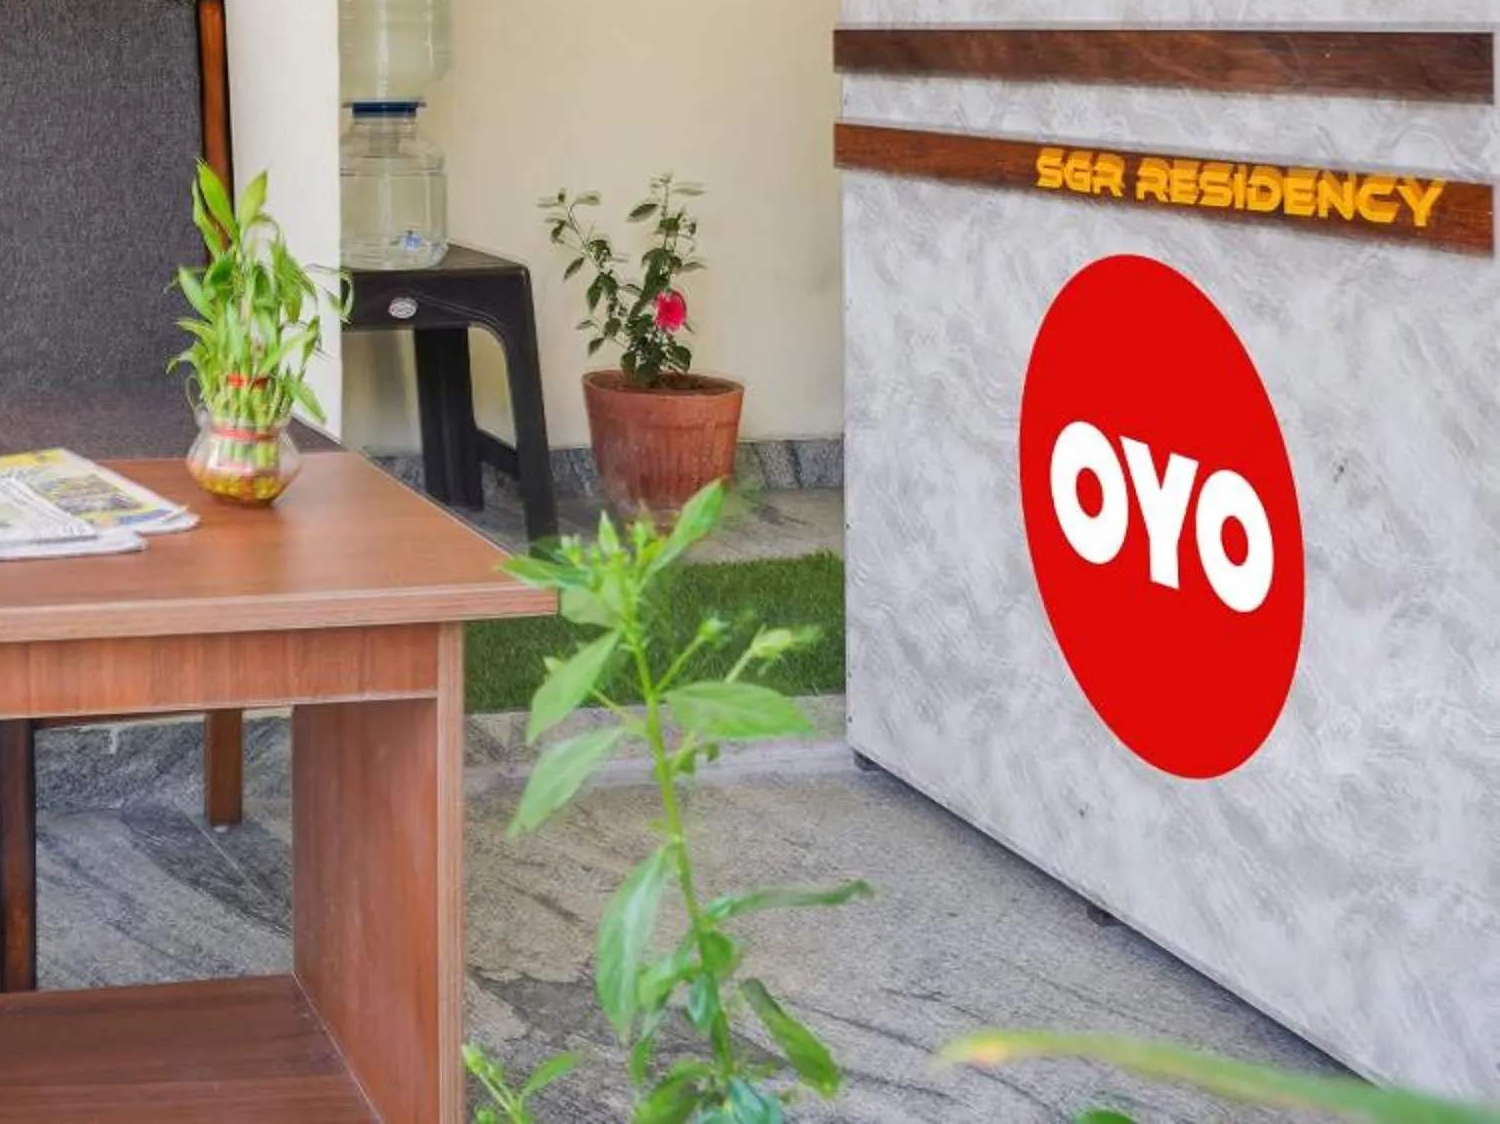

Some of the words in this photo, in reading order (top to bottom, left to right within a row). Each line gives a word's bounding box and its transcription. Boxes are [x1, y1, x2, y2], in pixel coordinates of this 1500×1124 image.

[1036, 148, 1124, 197] SGR
[1136, 157, 1443, 227] RESIDENCY
[1050, 420, 1274, 613] OYO
